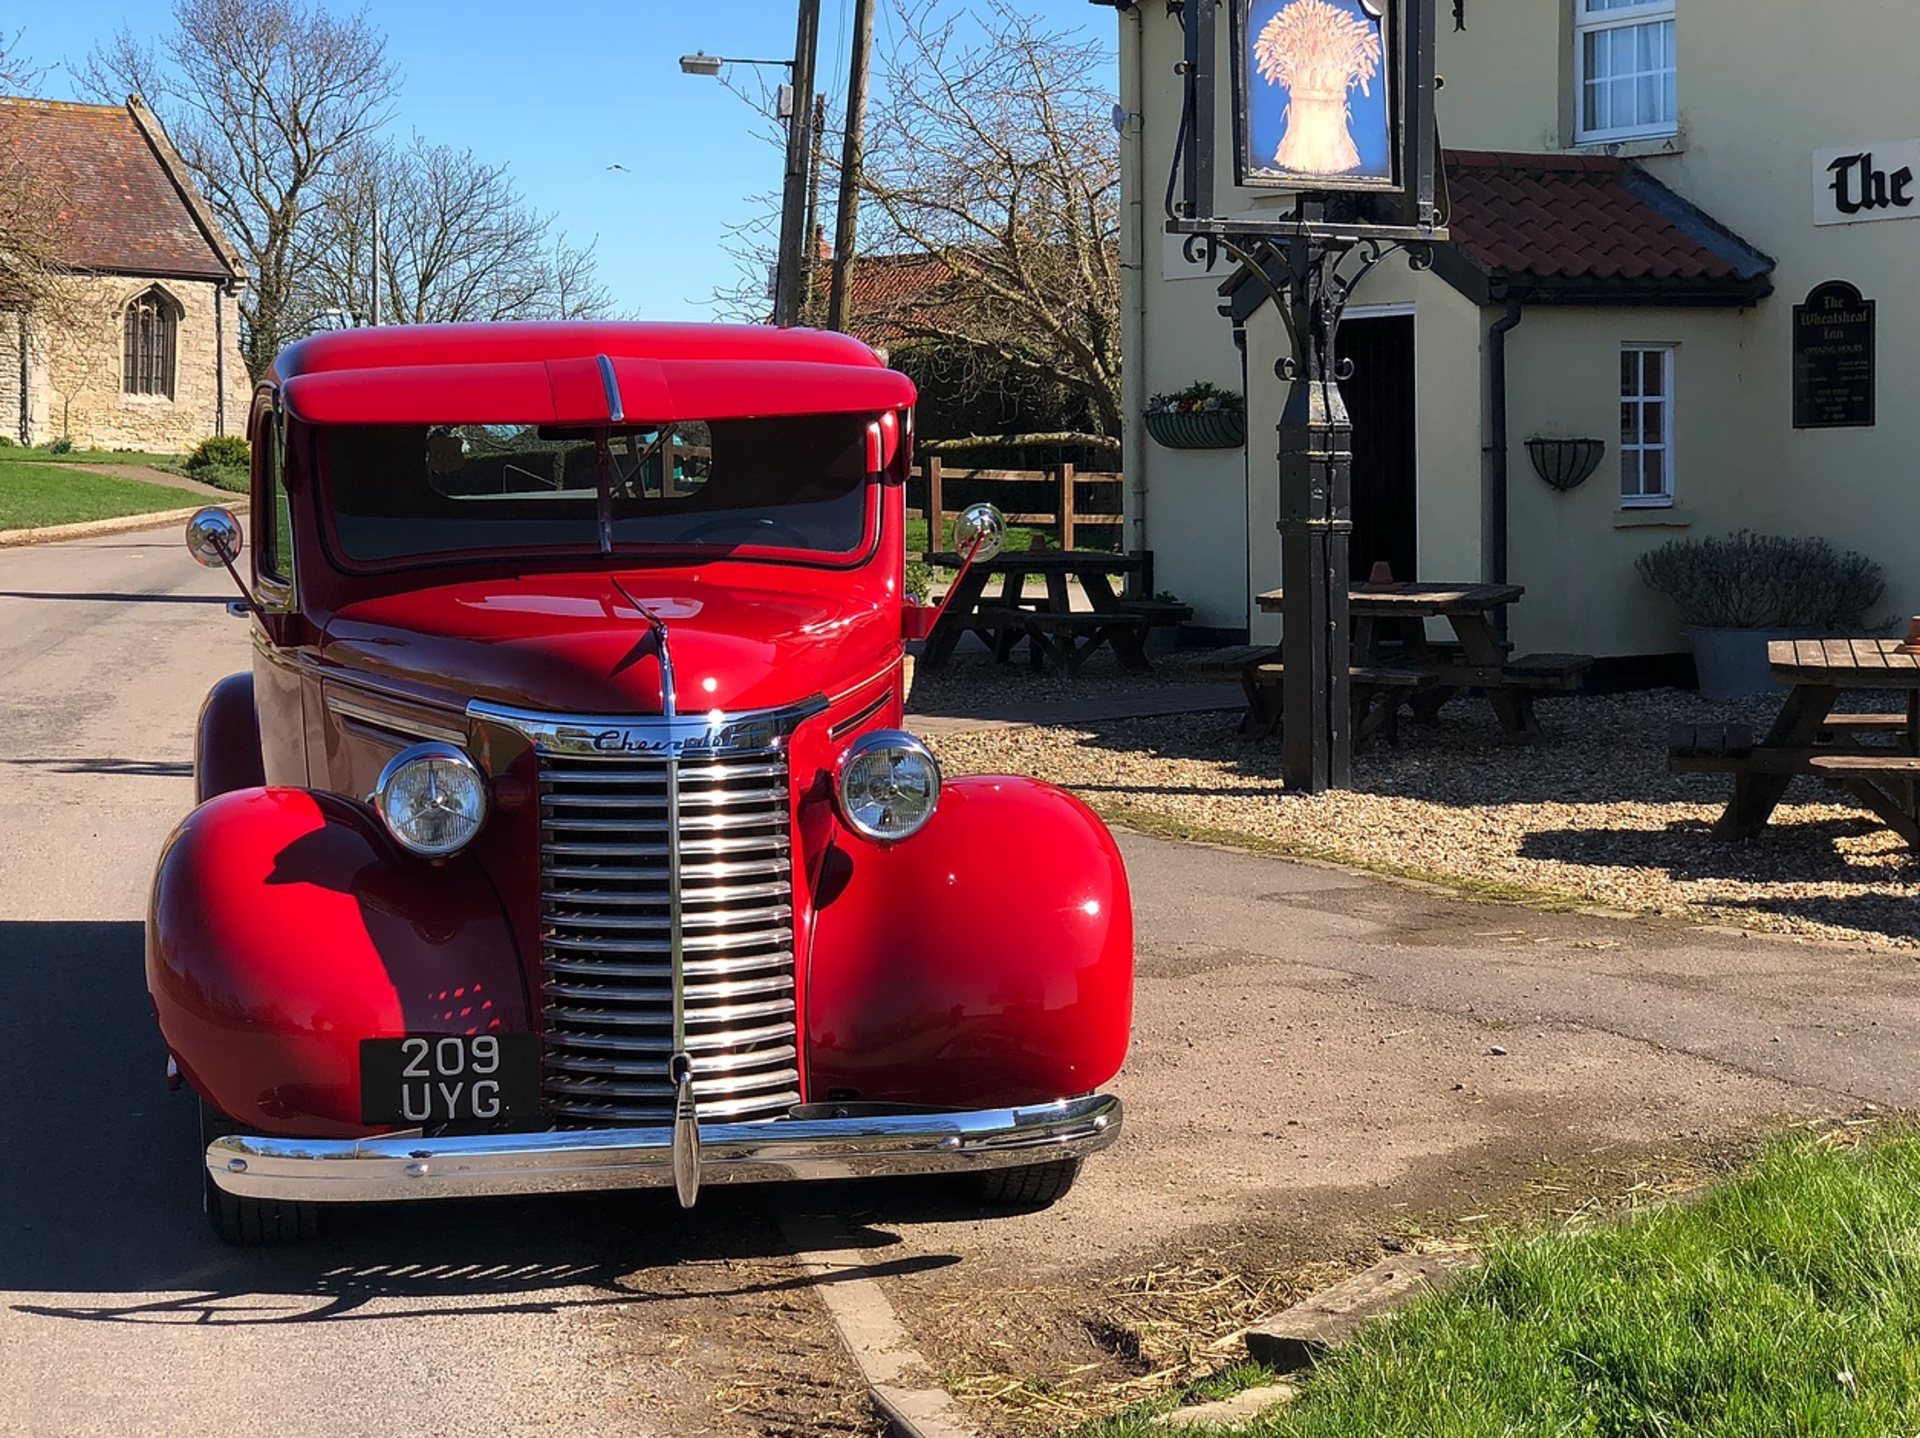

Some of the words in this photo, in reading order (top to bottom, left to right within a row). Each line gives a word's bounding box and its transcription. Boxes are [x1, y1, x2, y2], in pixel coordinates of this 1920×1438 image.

[1826, 152, 1914, 214] The
[1822, 296, 1844, 308] The
[1800, 309, 1868, 325] Wheatsheaf
[1823, 327, 1844, 340] Inn
[592, 727, 739, 751] Chevrolet
[401, 1035, 500, 1077] 209
[402, 1080, 500, 1121] UYG
